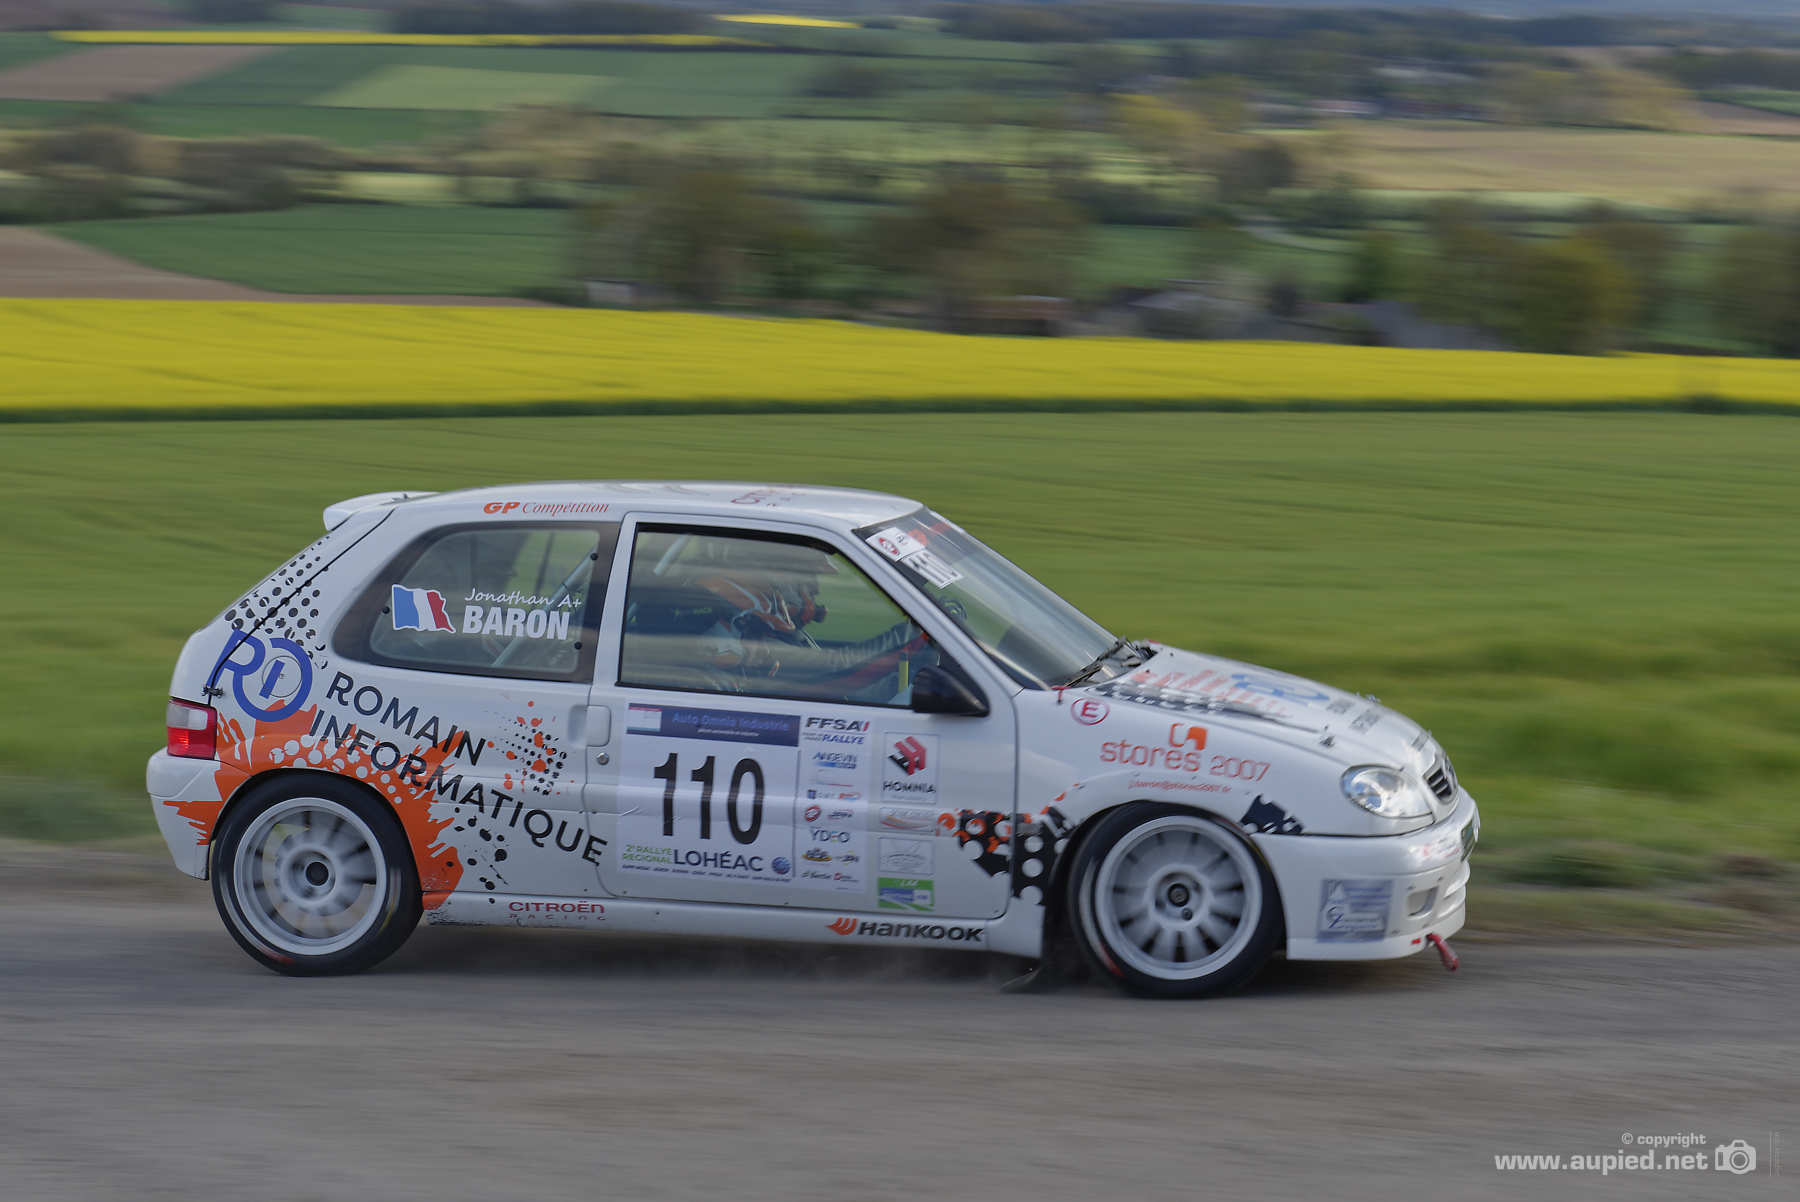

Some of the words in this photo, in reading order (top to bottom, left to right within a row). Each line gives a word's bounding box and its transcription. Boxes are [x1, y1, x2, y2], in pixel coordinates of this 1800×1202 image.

[484, 502, 520, 514] GP
[522, 502, 609, 516] Competition
[465, 588, 553, 605] Jonathan
[463, 605, 570, 640] BARON
[326, 671, 486, 766] ROMAIN
[806, 717, 864, 732] FFSA
[1100, 740, 1202, 772] stores
[1210, 754, 1271, 782] 2007
[309, 709, 608, 866] INFORMATIQUE
[653, 752, 765, 845] 110
[674, 849, 764, 872] LOHÉAC
